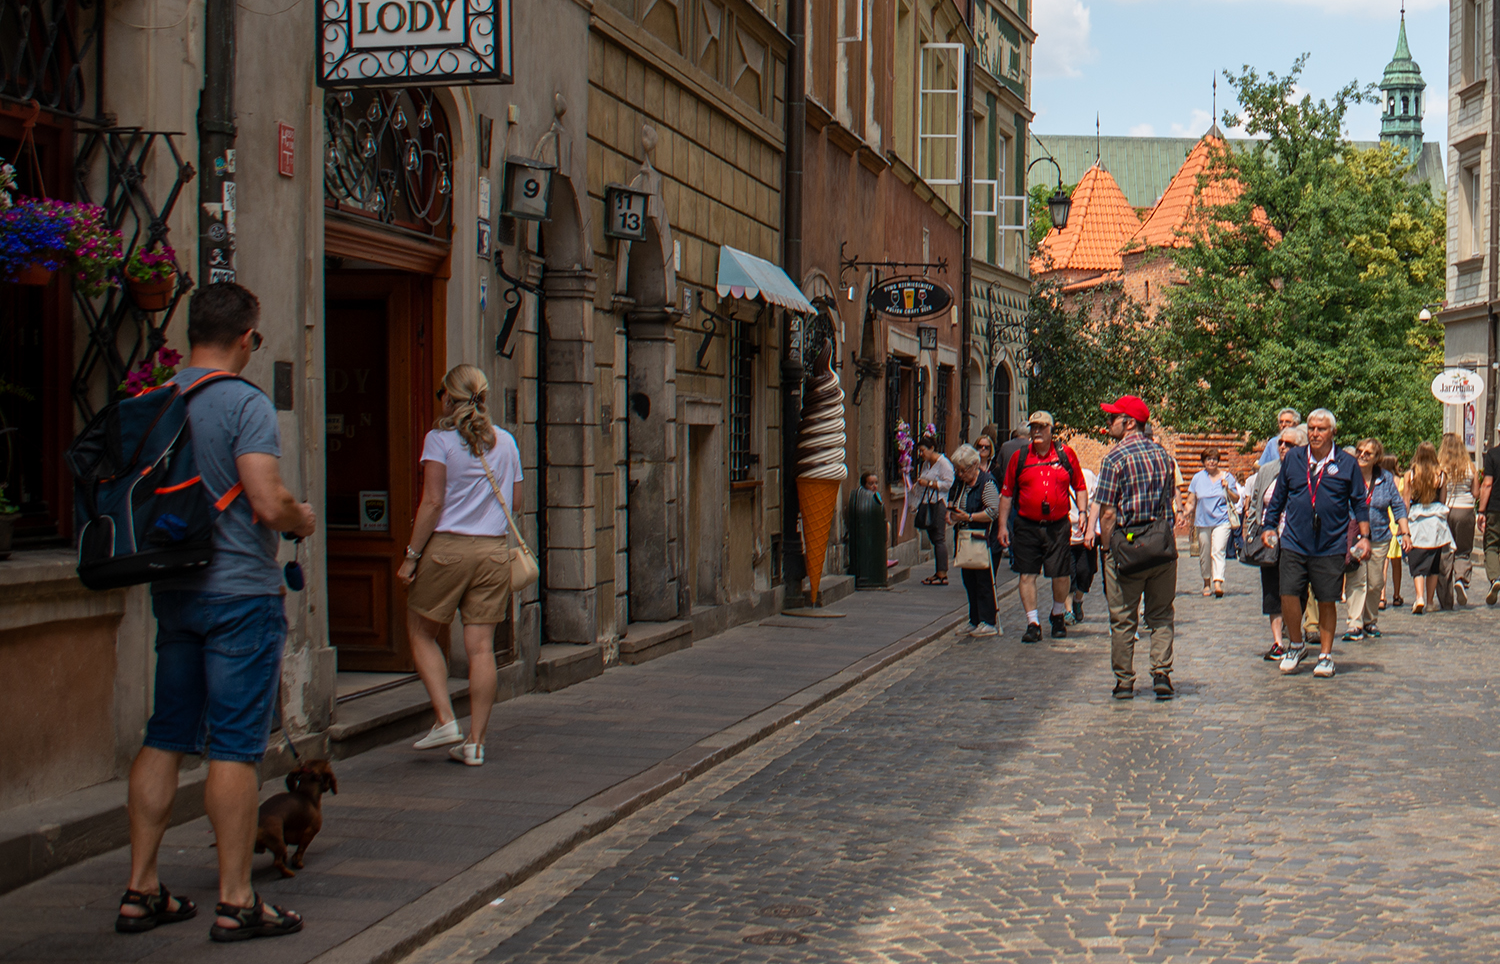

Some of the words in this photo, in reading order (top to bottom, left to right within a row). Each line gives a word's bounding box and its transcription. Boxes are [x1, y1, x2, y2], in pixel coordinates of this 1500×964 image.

[522, 178, 541, 199] 9
[615, 193, 633, 211] 11
[618, 212, 642, 231] 13
[885, 306, 903, 314] POLISH
[921, 305, 932, 313] BEER
